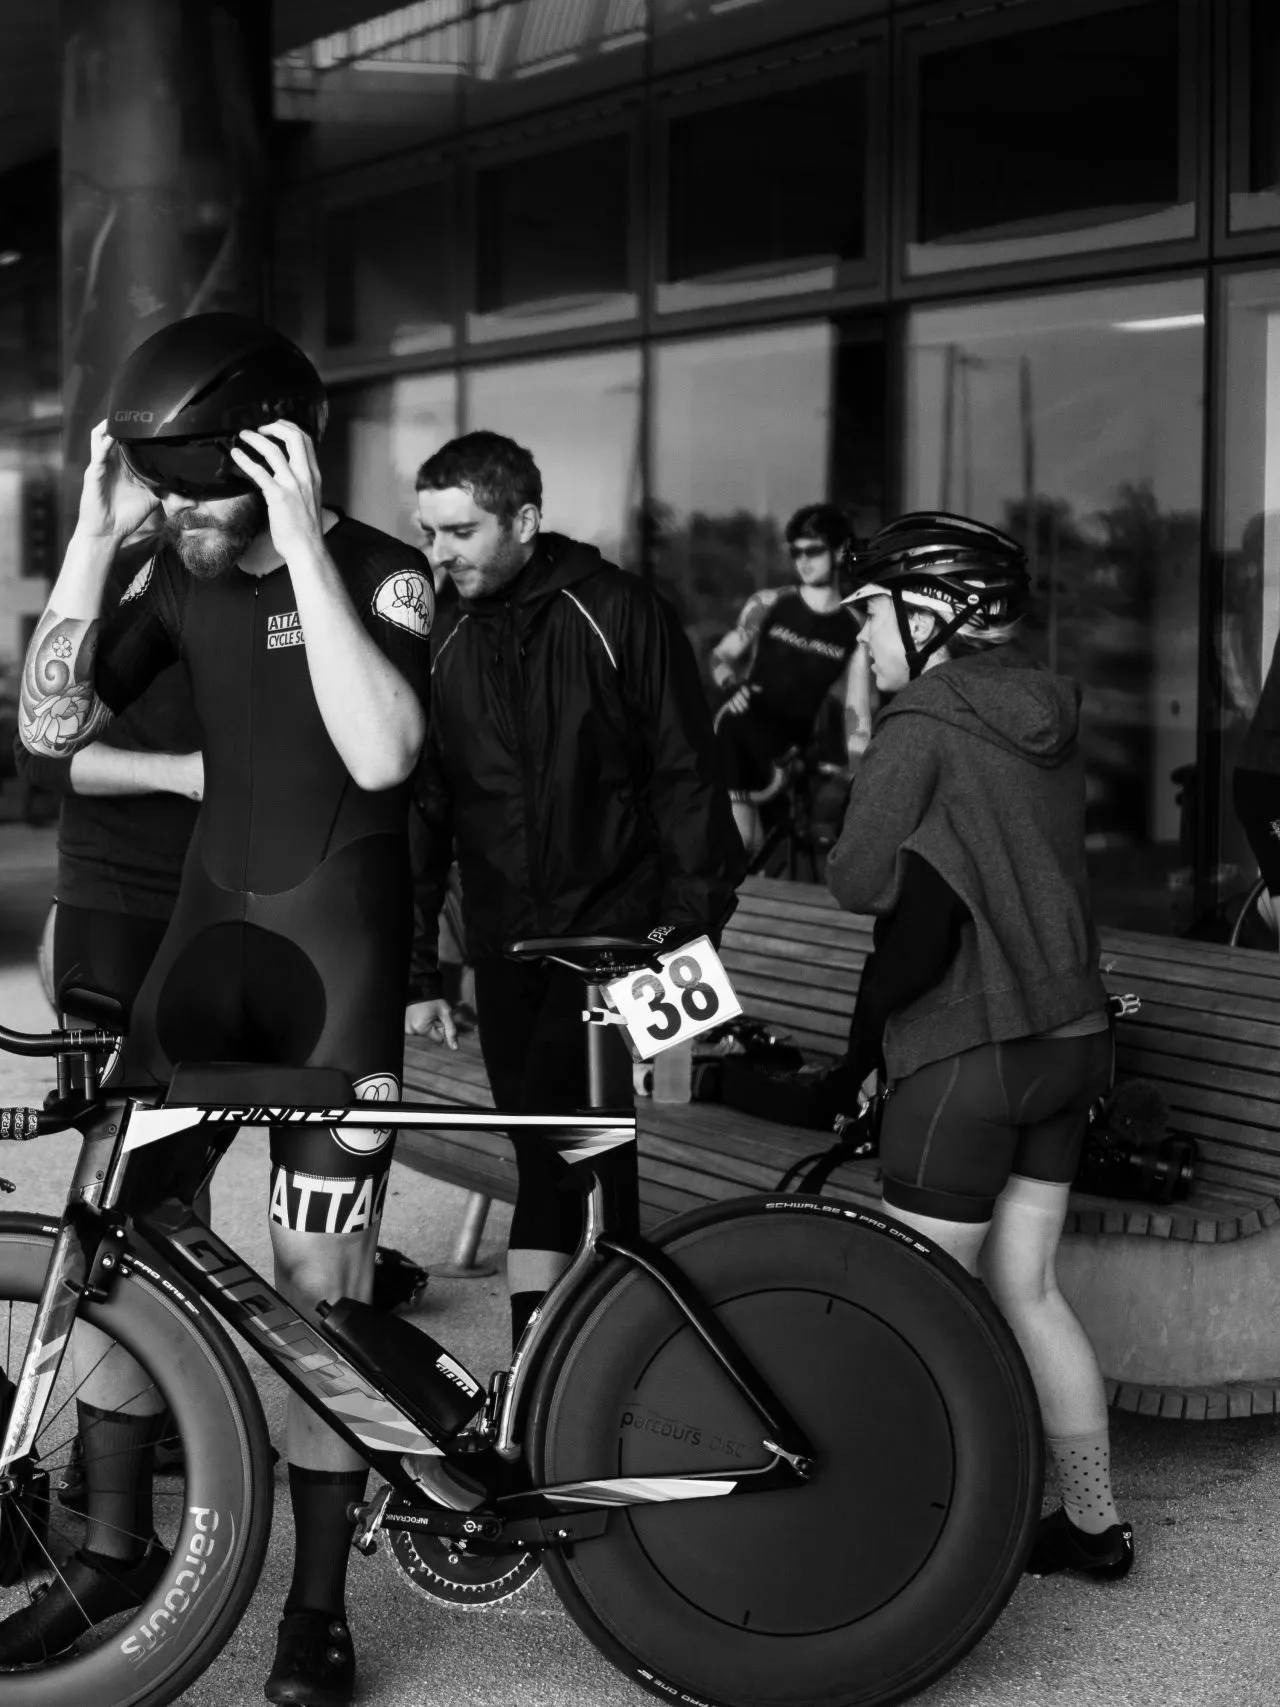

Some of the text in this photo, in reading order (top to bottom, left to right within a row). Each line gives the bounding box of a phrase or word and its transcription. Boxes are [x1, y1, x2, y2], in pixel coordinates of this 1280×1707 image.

[114, 409, 154, 423] GIRO
[269, 612, 300, 630] ATTA
[269, 631, 294, 647] CYCLE
[631, 955, 720, 1041] 38
[197, 1107, 351, 1122] TRINITY
[765, 1201, 914, 1244] SCHWALBE PRO ONE
[133, 1259, 186, 1301] PRO ONE
[620, 1411, 702, 1446] parcours
[385, 1513, 429, 1525] INFOCRANK
[120, 1506, 220, 1664] parcours
